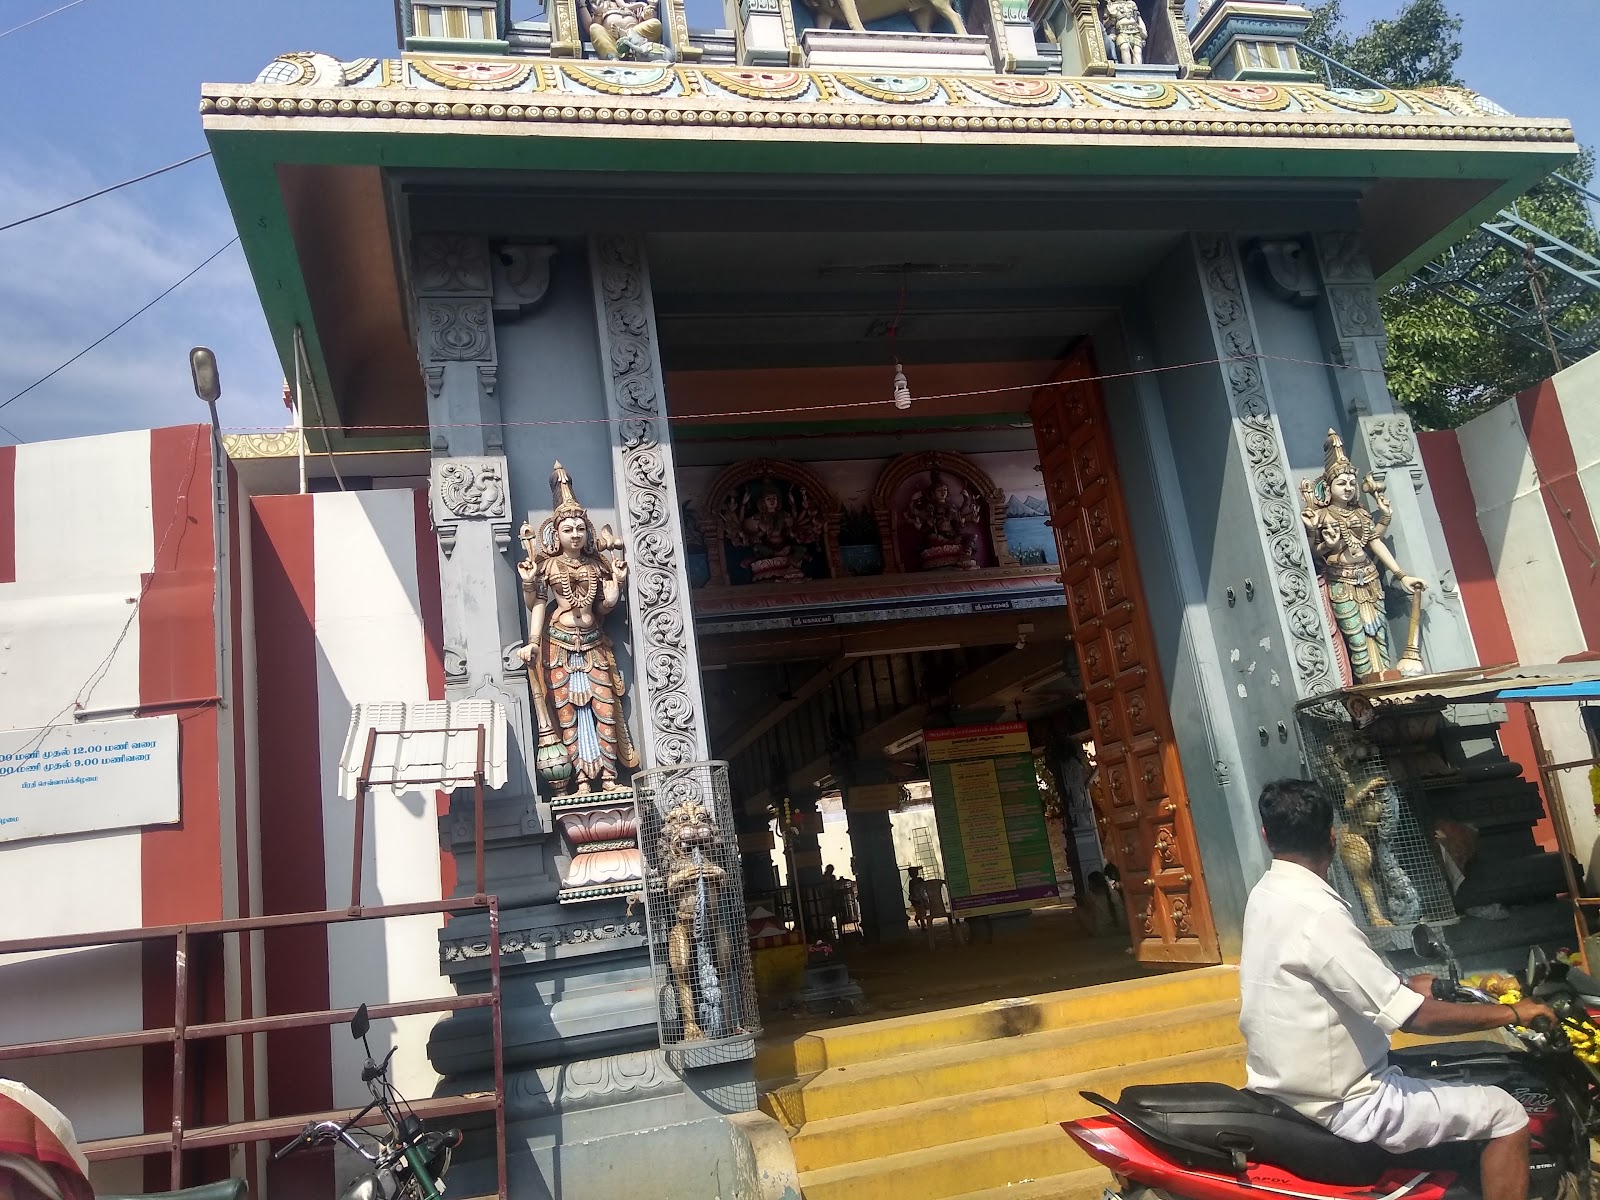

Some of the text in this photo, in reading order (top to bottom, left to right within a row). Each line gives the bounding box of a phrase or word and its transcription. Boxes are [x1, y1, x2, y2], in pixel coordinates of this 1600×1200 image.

[42, 747, 70, 759] முதல்
[73, 745, 102, 754] 12.00
[105, 741, 129, 751] மணி
[131, 741, 156, 749] வரை
[43, 760, 71, 771] முதல்
[74, 758, 98, 767] 9.00
